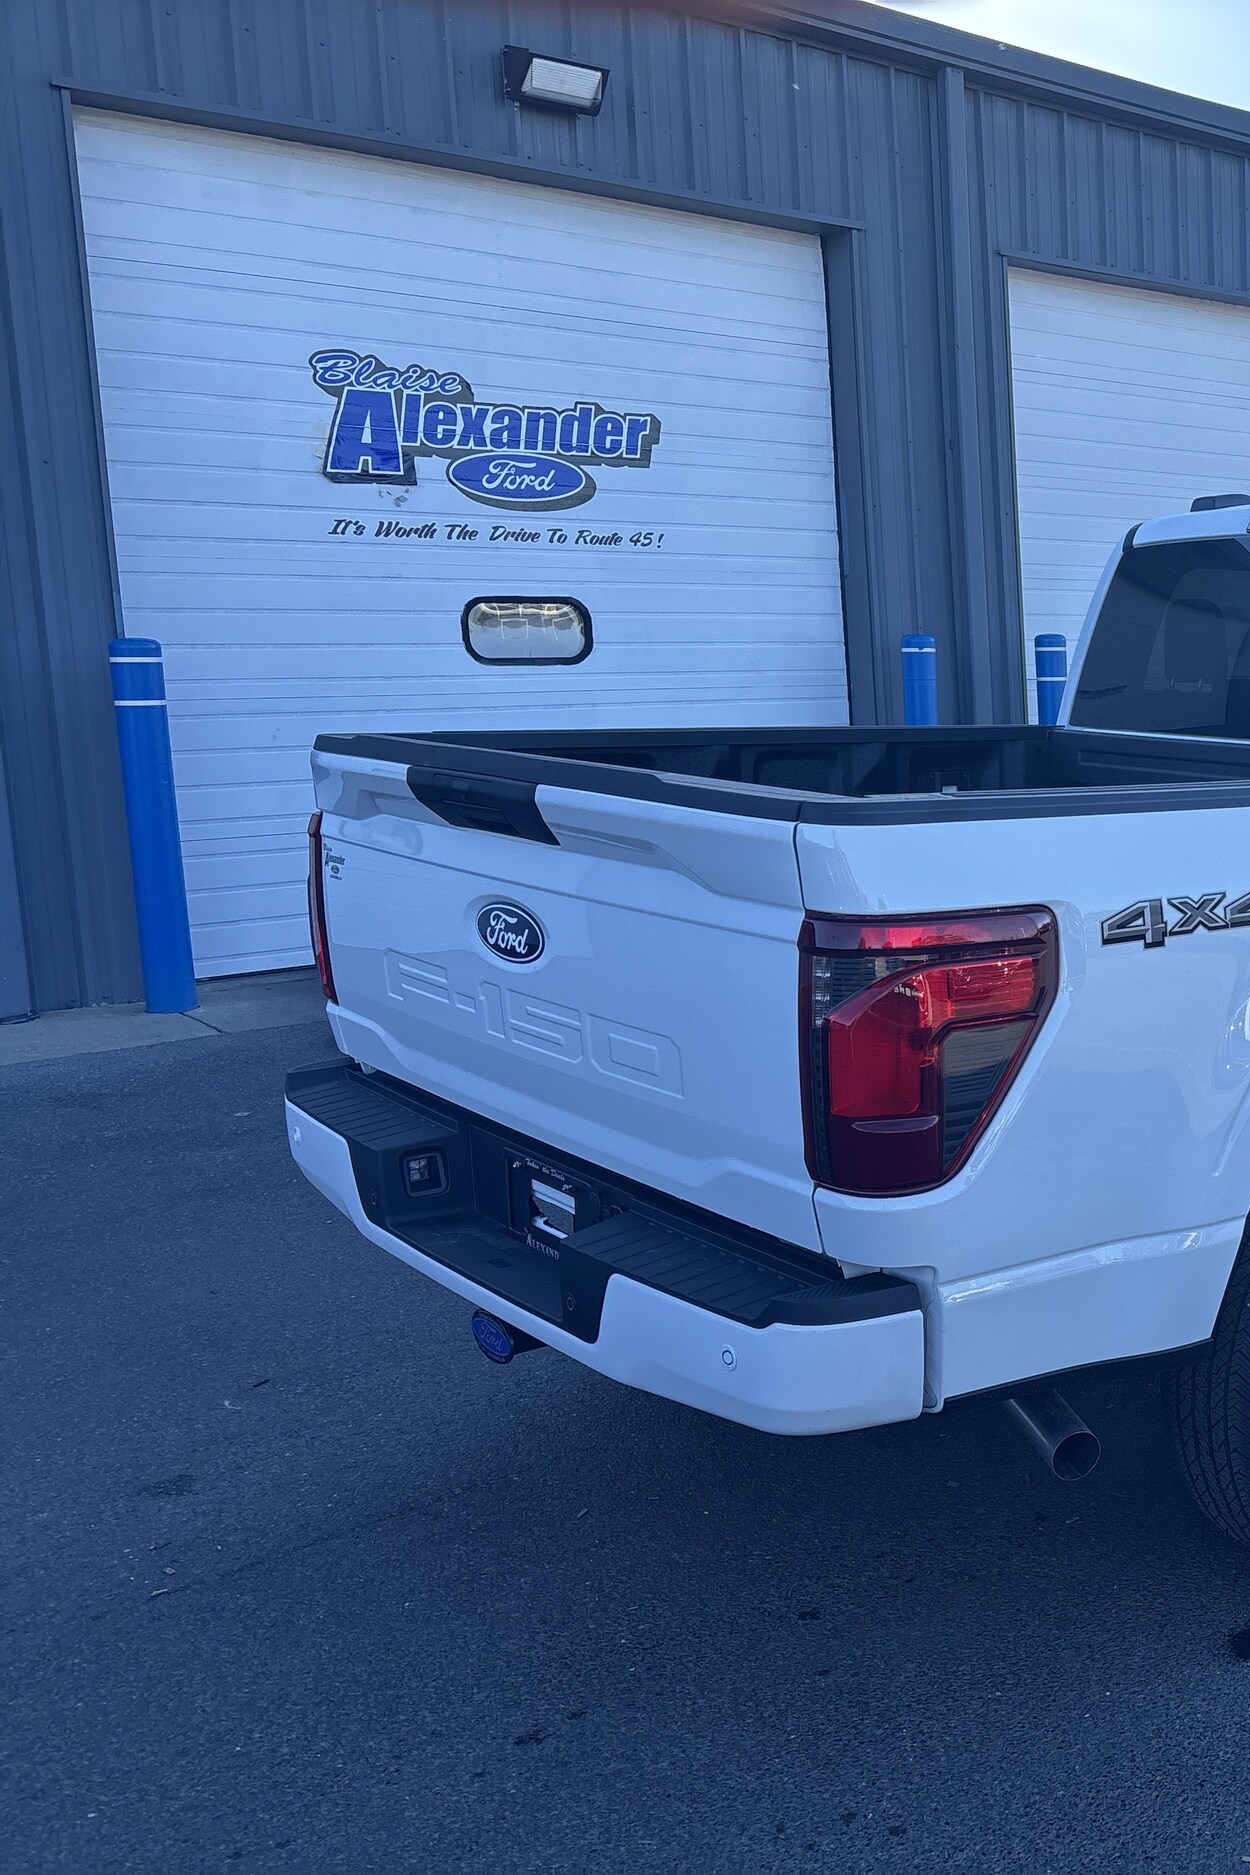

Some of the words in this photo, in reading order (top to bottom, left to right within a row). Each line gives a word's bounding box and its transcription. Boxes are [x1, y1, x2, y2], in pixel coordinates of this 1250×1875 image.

[312, 351, 463, 395] Blaise
[326, 386, 651, 475] Alexander
[482, 458, 556, 493] Ford
[328, 518, 366, 537] It's
[374, 520, 438, 540] Worth
[444, 523, 479, 541] The
[488, 525, 542, 544] Drive
[546, 528, 568, 545] To
[574, 529, 624, 547] Route
[487, 910, 529, 954] Ford
[383, 947, 685, 1099] F-150
[526, 1233, 560, 1261] ALEXAND
[480, 1321, 503, 1351] Ford
